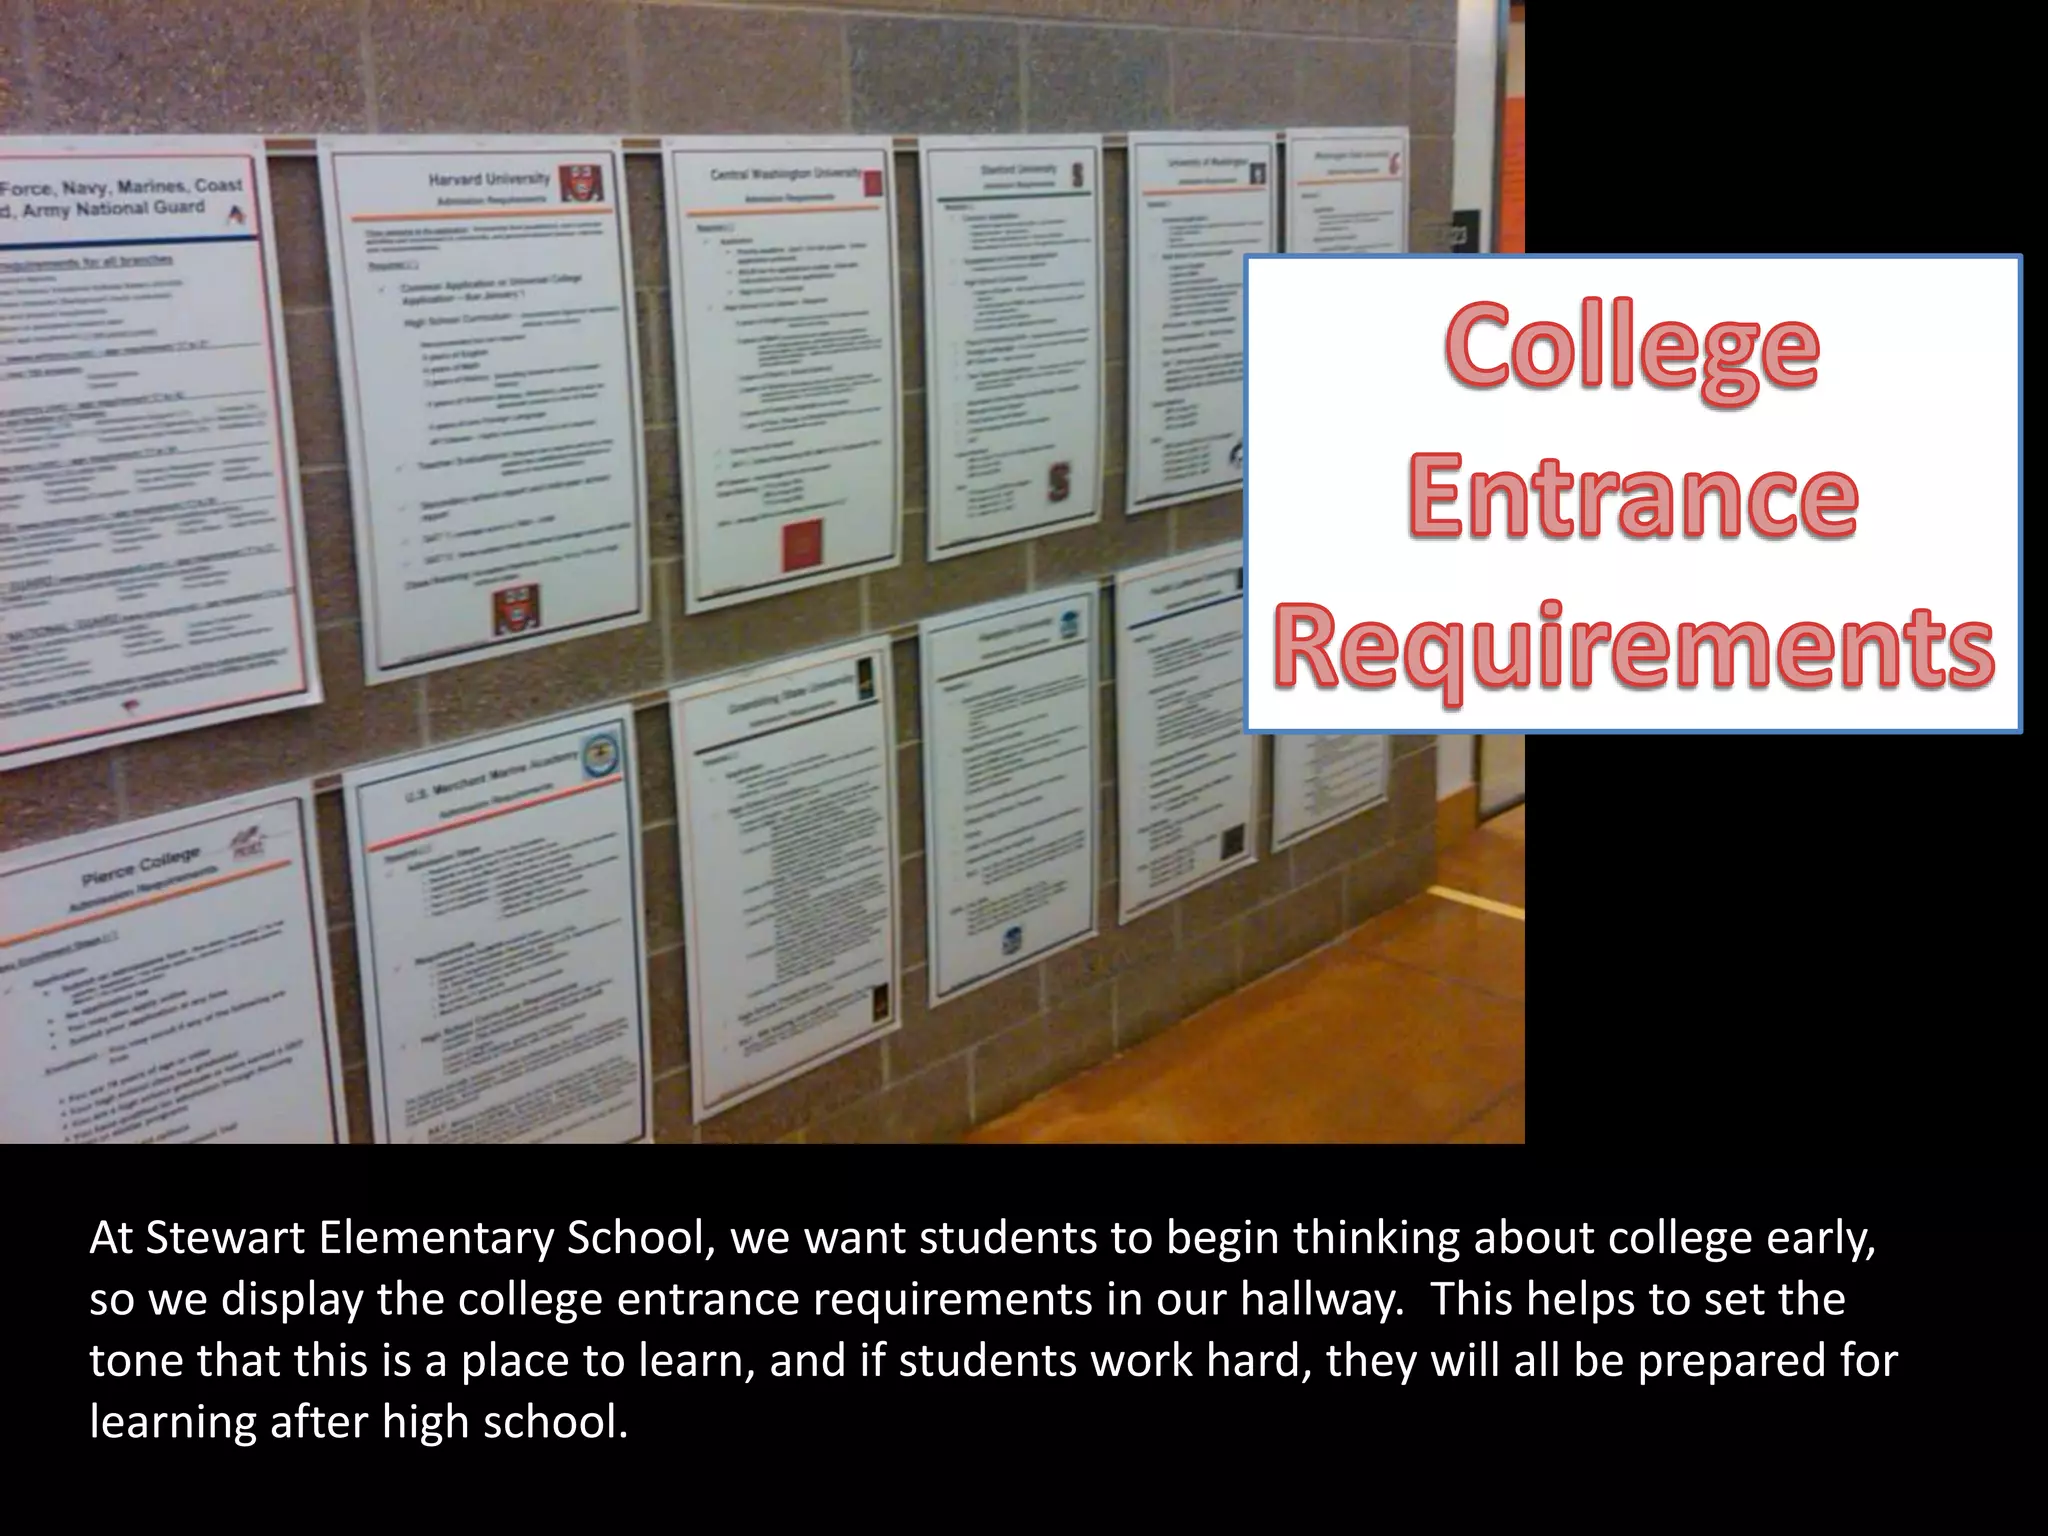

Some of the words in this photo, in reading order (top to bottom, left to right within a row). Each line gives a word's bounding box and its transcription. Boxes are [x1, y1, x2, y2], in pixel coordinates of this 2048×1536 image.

[428, 172, 482, 186] Harvard
[486, 170, 550, 187] University
[710, 168, 749, 181] Central
[751, 168, 811, 182] Washington
[813, 166, 862, 179] University
[62, 180, 112, 198] Navy,
[195, 178, 243, 193] Coast
[23, 202, 70, 221] Army
[76, 199, 148, 216] National
[154, 198, 205, 213] Guard
[433, 775, 486, 795] Merchant
[489, 764, 527, 780] Marine
[82, 863, 135, 888] Pierce
[139, 846, 202, 872] College
